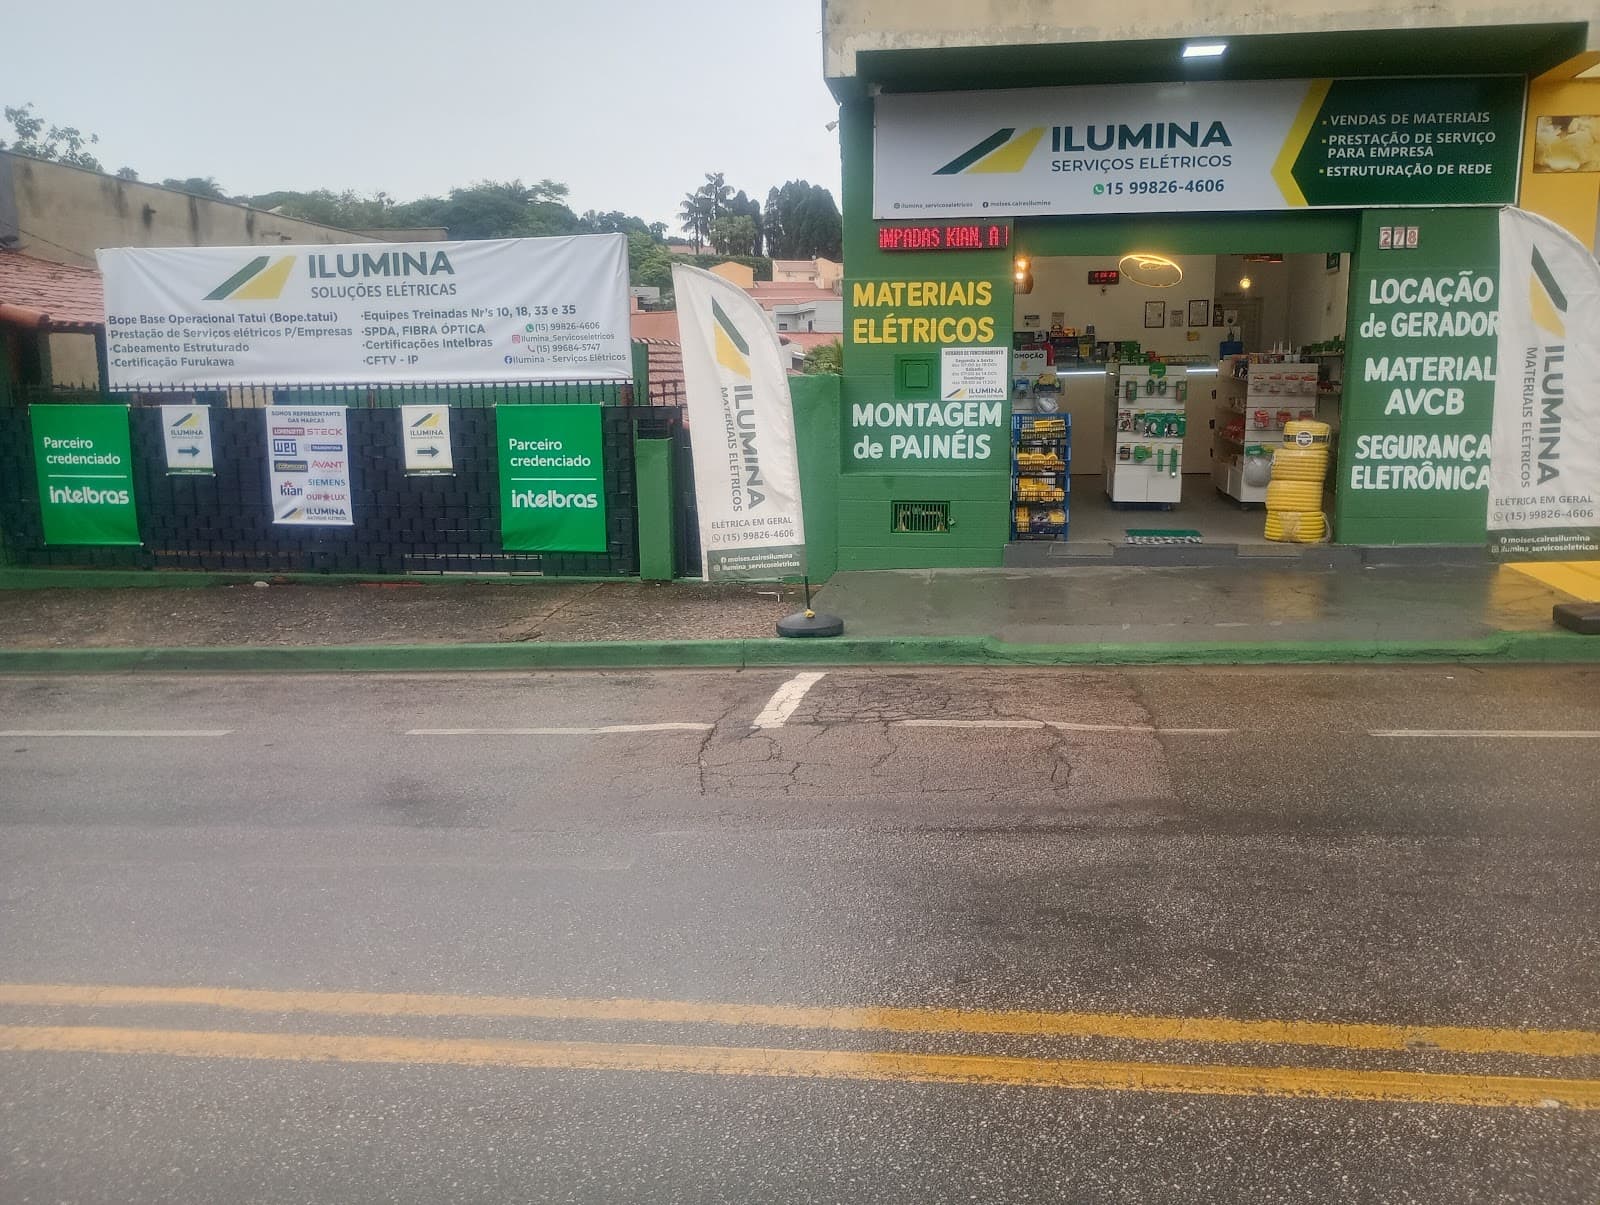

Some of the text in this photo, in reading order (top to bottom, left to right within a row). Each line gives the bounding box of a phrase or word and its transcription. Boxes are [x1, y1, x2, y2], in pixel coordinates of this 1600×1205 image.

[1330, 111, 1490, 126] VENDAS DE MATERIAIS
[1052, 120, 1233, 152] ILUMINA
[1328, 131, 1496, 146] PRESTAÇÃO DE SERVIÇO
[1328, 146, 1434, 159] PARA EMPRESA
[1051, 153, 1232, 174] SERVIÇOS ELÉTRICOS
[1326, 162, 1492, 178] ESTRUTURAÇÃO DE REDE
[1105, 179, 1225, 195] 15 99826-4606
[1381, 229, 1417, 247] 278
[308, 250, 456, 279] ILUMINA
[311, 280, 457, 301] SOLUÇÕES ELÉTRICAS
[852, 281, 992, 307] MATERIAIS
[1369, 270, 1494, 307] LOCAÇÃO
[108, 311, 338, 328] Bope Base Operacional Tatui (Bope.tatui)
[363, 311, 409, 324] Equipes
[412, 308, 468, 320] Treinadas
[497, 307, 513, 319] 10,
[515, 306, 532, 318] 18,
[534, 305, 549, 316] 33
[551, 307, 559, 316] e
[562, 304, 577, 315] 35
[110, 326, 353, 341] Prestação de Serviços elétricos P/Empresas
[363, 322, 486, 339] SPDA, FIBRA ÓPTICA
[535, 321, 600, 333] (15) 99826-4606
[853, 312, 995, 344] ELÉTRICOS
[1359, 312, 1387, 338] de
[112, 342, 250, 354] Cabeamento Estruturado
[365, 337, 494, 351] Certificações Intelbras
[536, 343, 601, 354] (15) 99684-5747
[113, 356, 235, 369] Certificação Furukawa
[365, 355, 398, 366] CFTV
[407, 354, 419, 366] IP
[552, 354, 588, 364] Serviços
[1364, 356, 1497, 382] MATERIAL
[1522, 347, 1538, 418] MATERIAIS
[1384, 387, 1465, 416] AVCB
[720, 386, 738, 450] MATERIAIS
[852, 402, 1002, 427] MONTAGEM
[1537, 345, 1565, 486] ILUMINA
[306, 428, 343, 436] STECK
[43, 436, 94, 449] Parceiro
[508, 438, 563, 451] Parceiro
[733, 385, 766, 510] ILUMINA
[853, 428, 992, 460] de PAINÉIS
[1355, 434, 1492, 462] SEGURANÇA
[46, 452, 121, 465] credenciado
[510, 454, 592, 467] credenciado
[1520, 421, 1535, 489] ELÉTRICOS
[312, 460, 345, 469] AVANT
[308, 478, 346, 486] SIEMENS
[728, 452, 743, 513] ELÉTRICOS
[1350, 460, 1491, 490] ELETRÔNICA
[49, 485, 130, 505] intelbras
[511, 489, 599, 509] intelbras
[1495, 495, 1593, 506] ELÉTRICA EM GERAL
[306, 508, 346, 516] ILUMINA
[1504, 509, 1594, 522] (15) 99826-4606
[711, 516, 793, 529] ELÉTRICA EM GERAL
[722, 529, 795, 543] (15) 99826-4606
